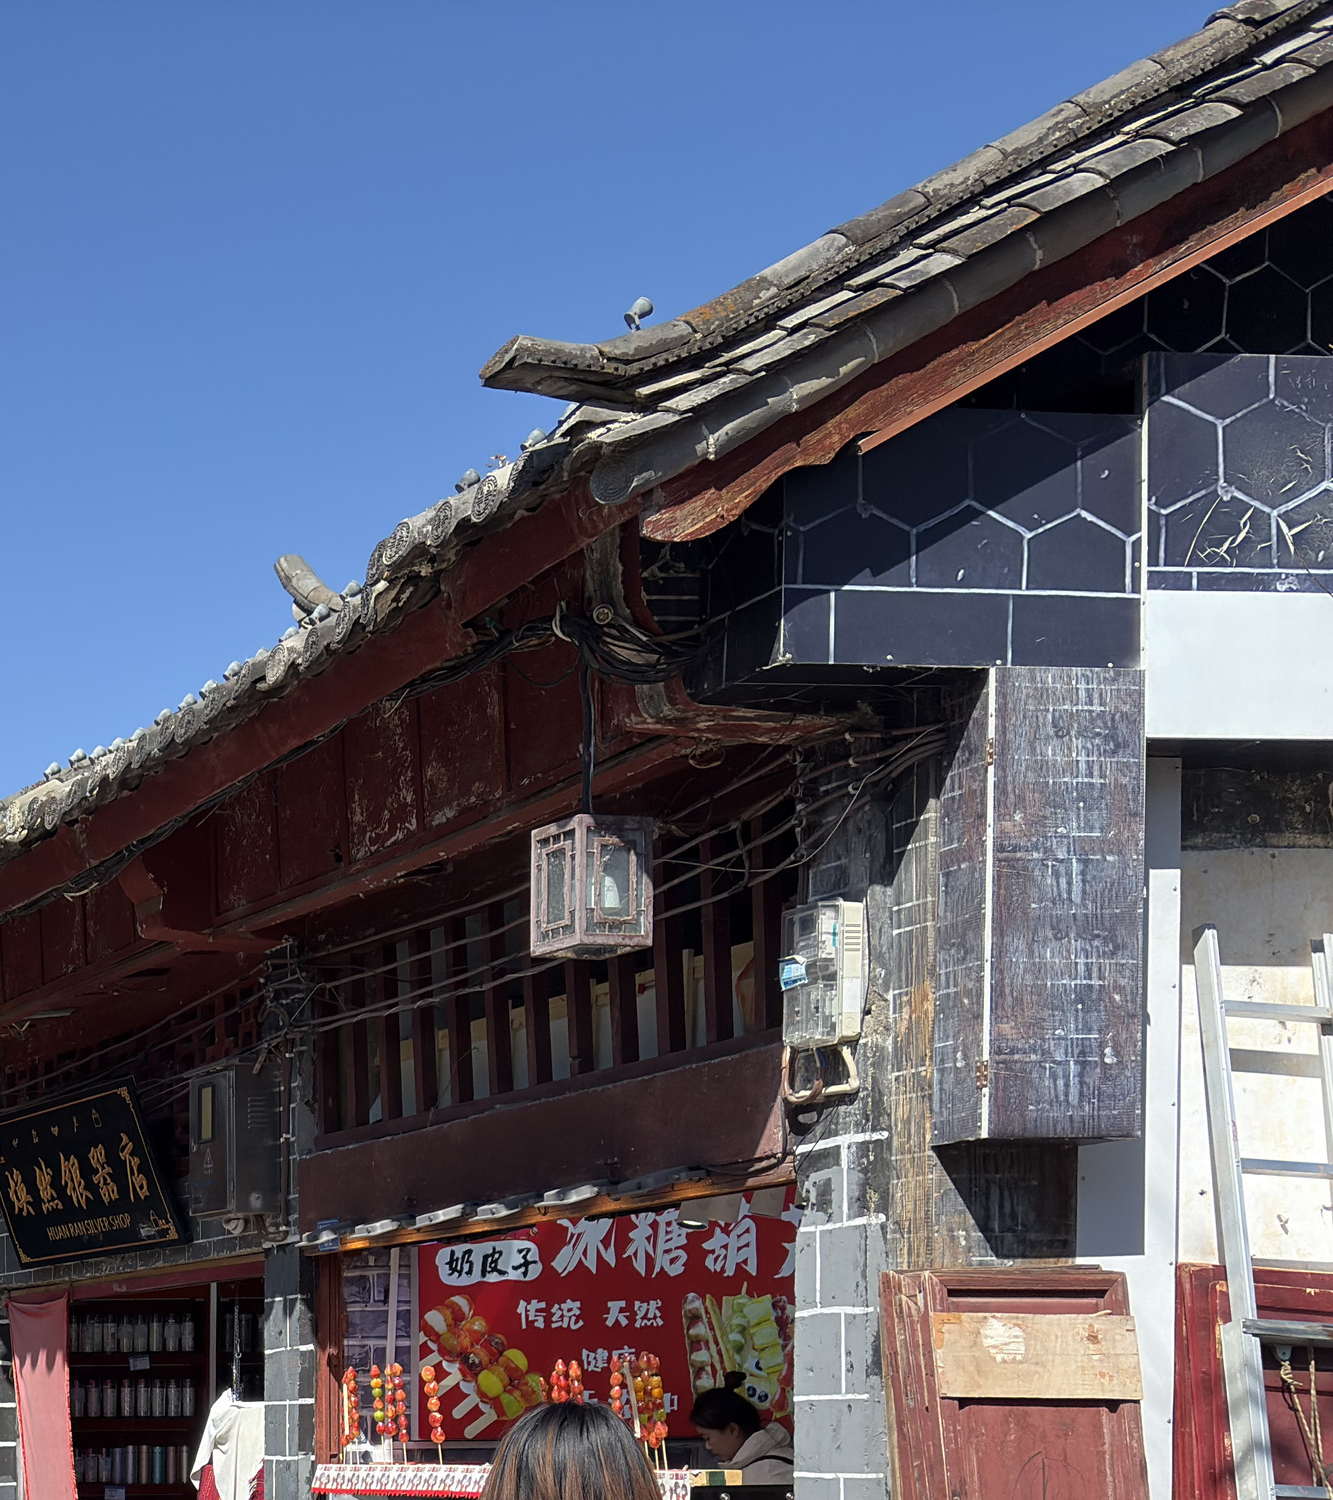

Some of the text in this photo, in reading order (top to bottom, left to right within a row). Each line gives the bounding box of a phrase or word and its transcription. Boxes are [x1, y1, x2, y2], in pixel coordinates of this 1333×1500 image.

[47, 1213, 131, 1241] HUAN RAN SILVER SHOP
[551, 1198, 795, 1279] 冰糖葫
[446, 1247, 539, 1279] 奶皮子
[517, 1299, 664, 1330] 传统 天然
